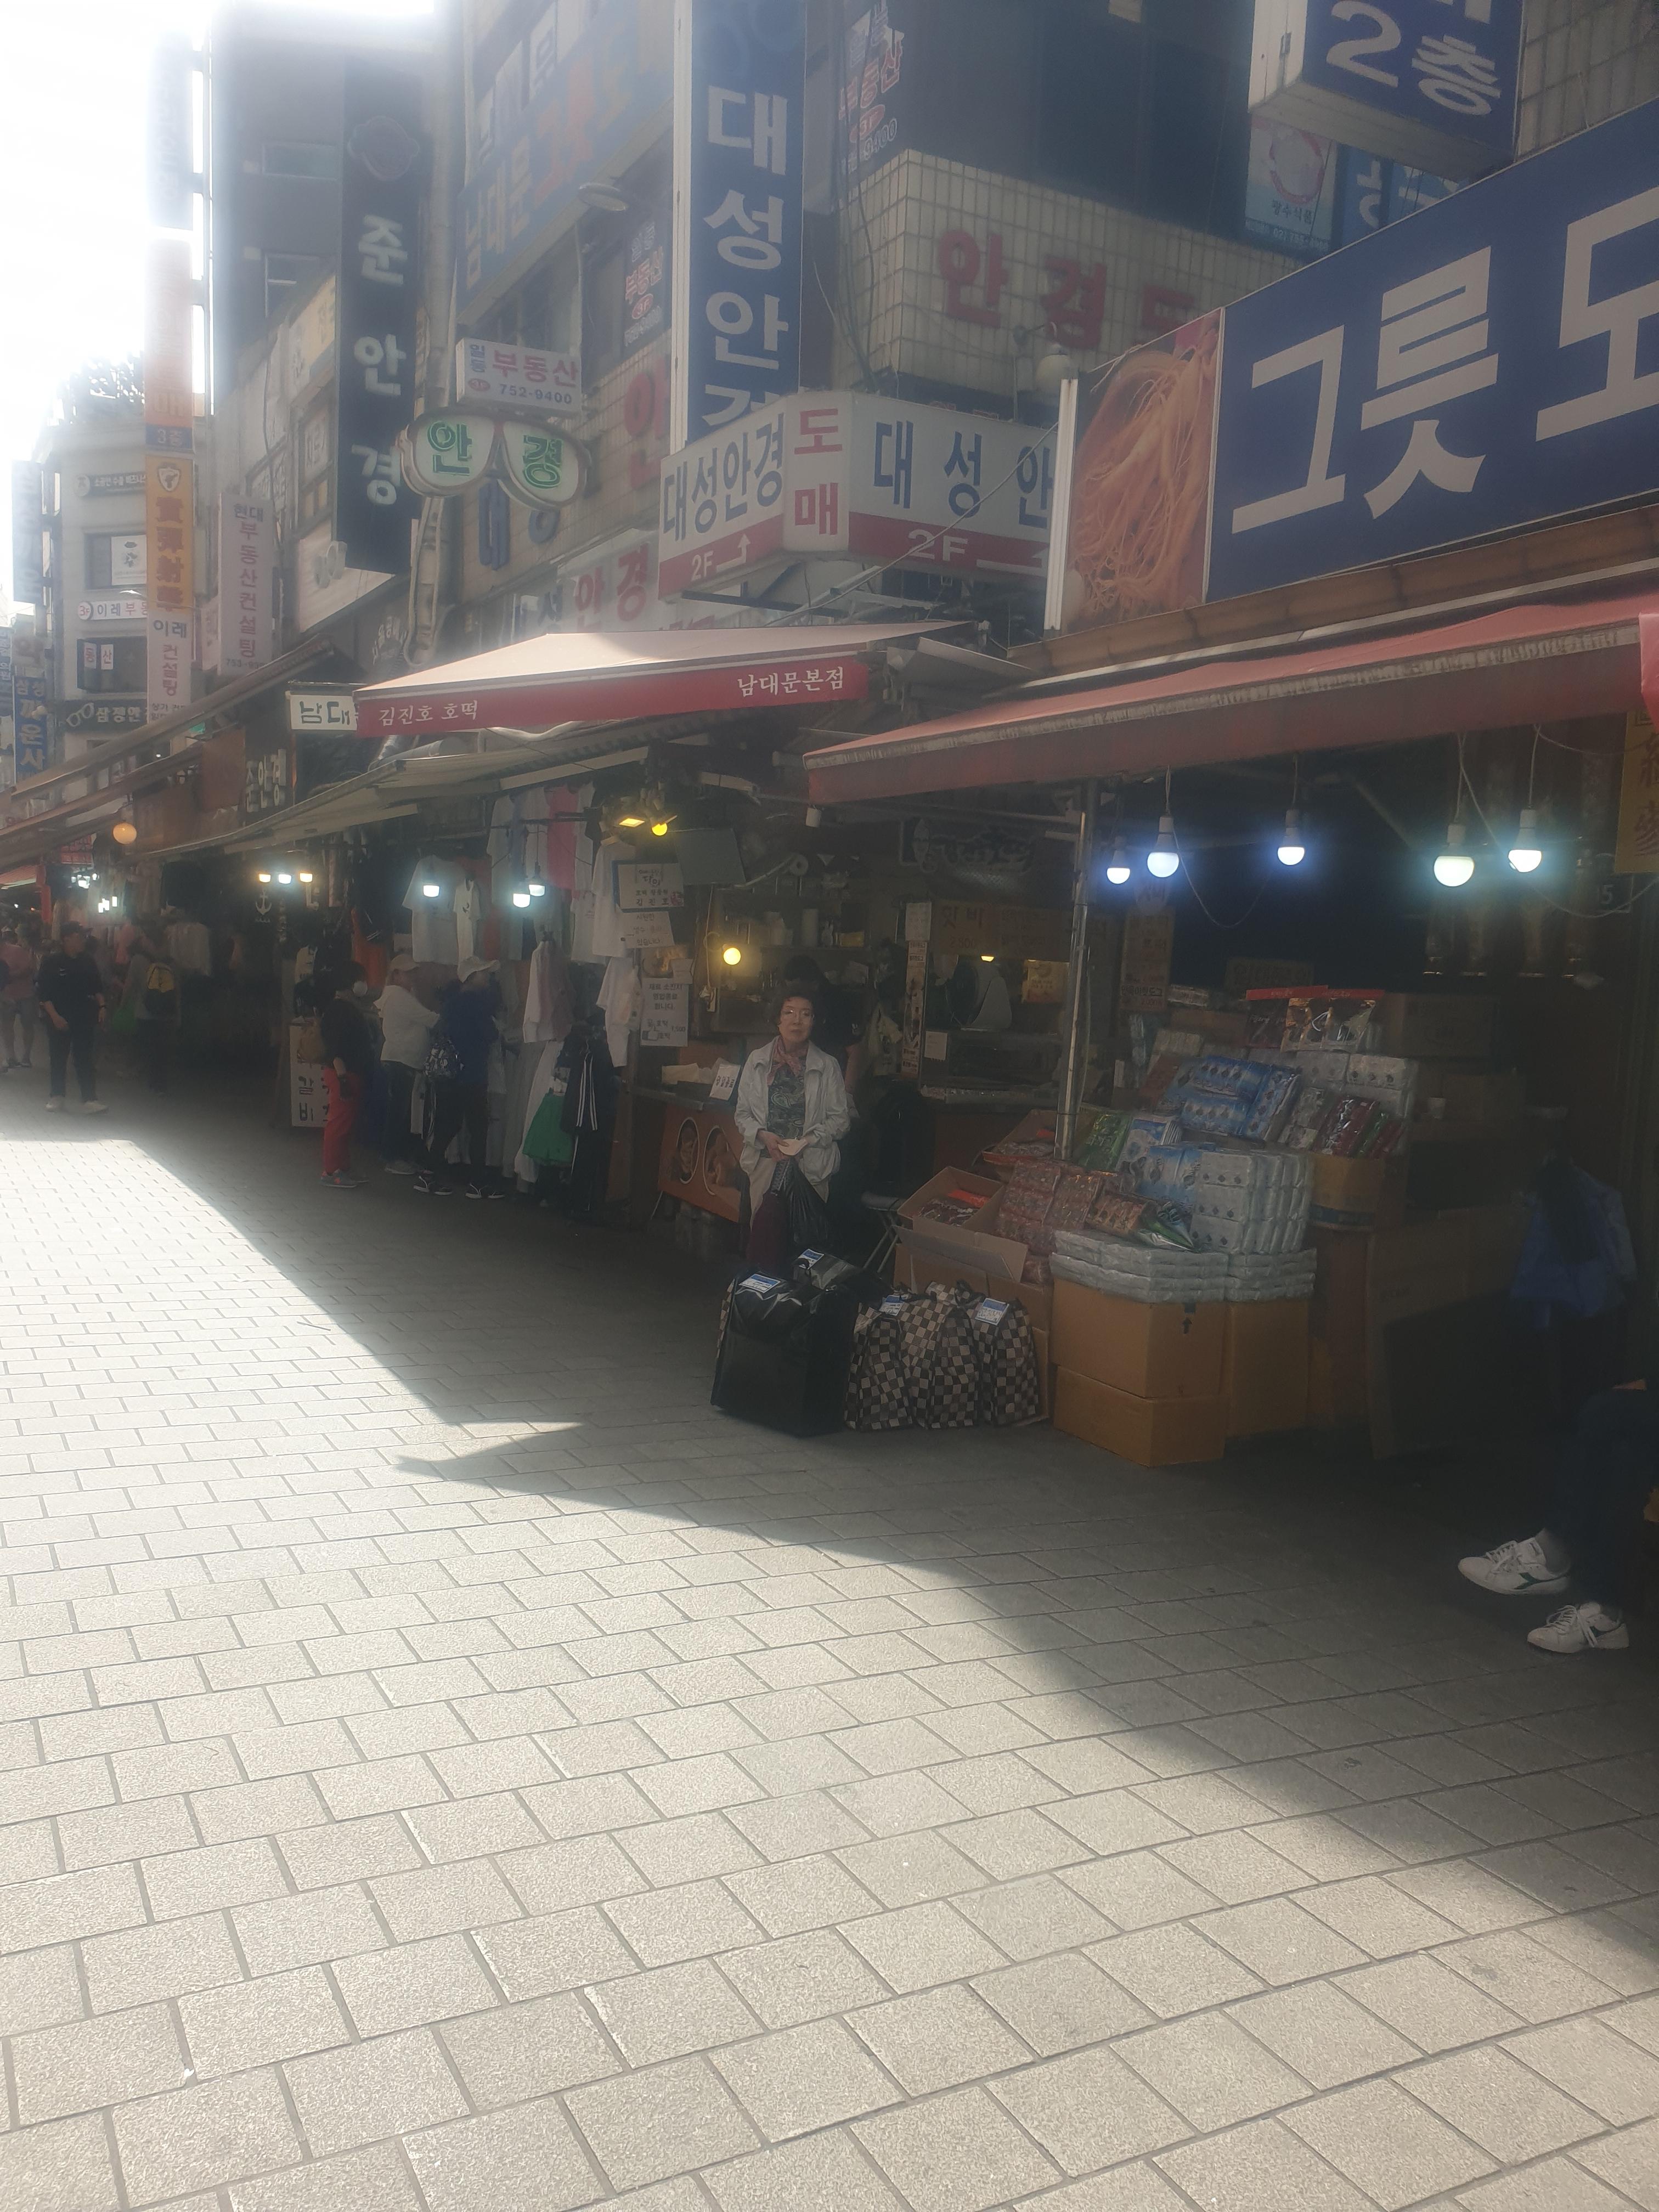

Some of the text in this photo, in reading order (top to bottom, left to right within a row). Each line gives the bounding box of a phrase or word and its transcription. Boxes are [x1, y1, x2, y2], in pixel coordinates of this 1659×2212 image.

[1327, 0, 1501, 116] 2층
[624, 245, 664, 304] 부동산
[491, 349, 578, 388] 부동산
[498, 383, 573, 405] 752-9400
[662, 413, 785, 541] 대성안경
[793, 408, 843, 537] 도매
[234, 503, 264, 523] 현대
[907, 529, 969, 562] 2F
[691, 550, 714, 581] 2F
[239, 521, 260, 659] 부동산컨설팅
[79, 606, 90, 617] 3F
[153, 619, 187, 638] 이레
[162, 644, 178, 697] 컨설팅
[737, 667, 844, 698] 남대문본점
[96, 706, 148, 724] 삼정안
[378, 700, 478, 726] 김진호 호떡
